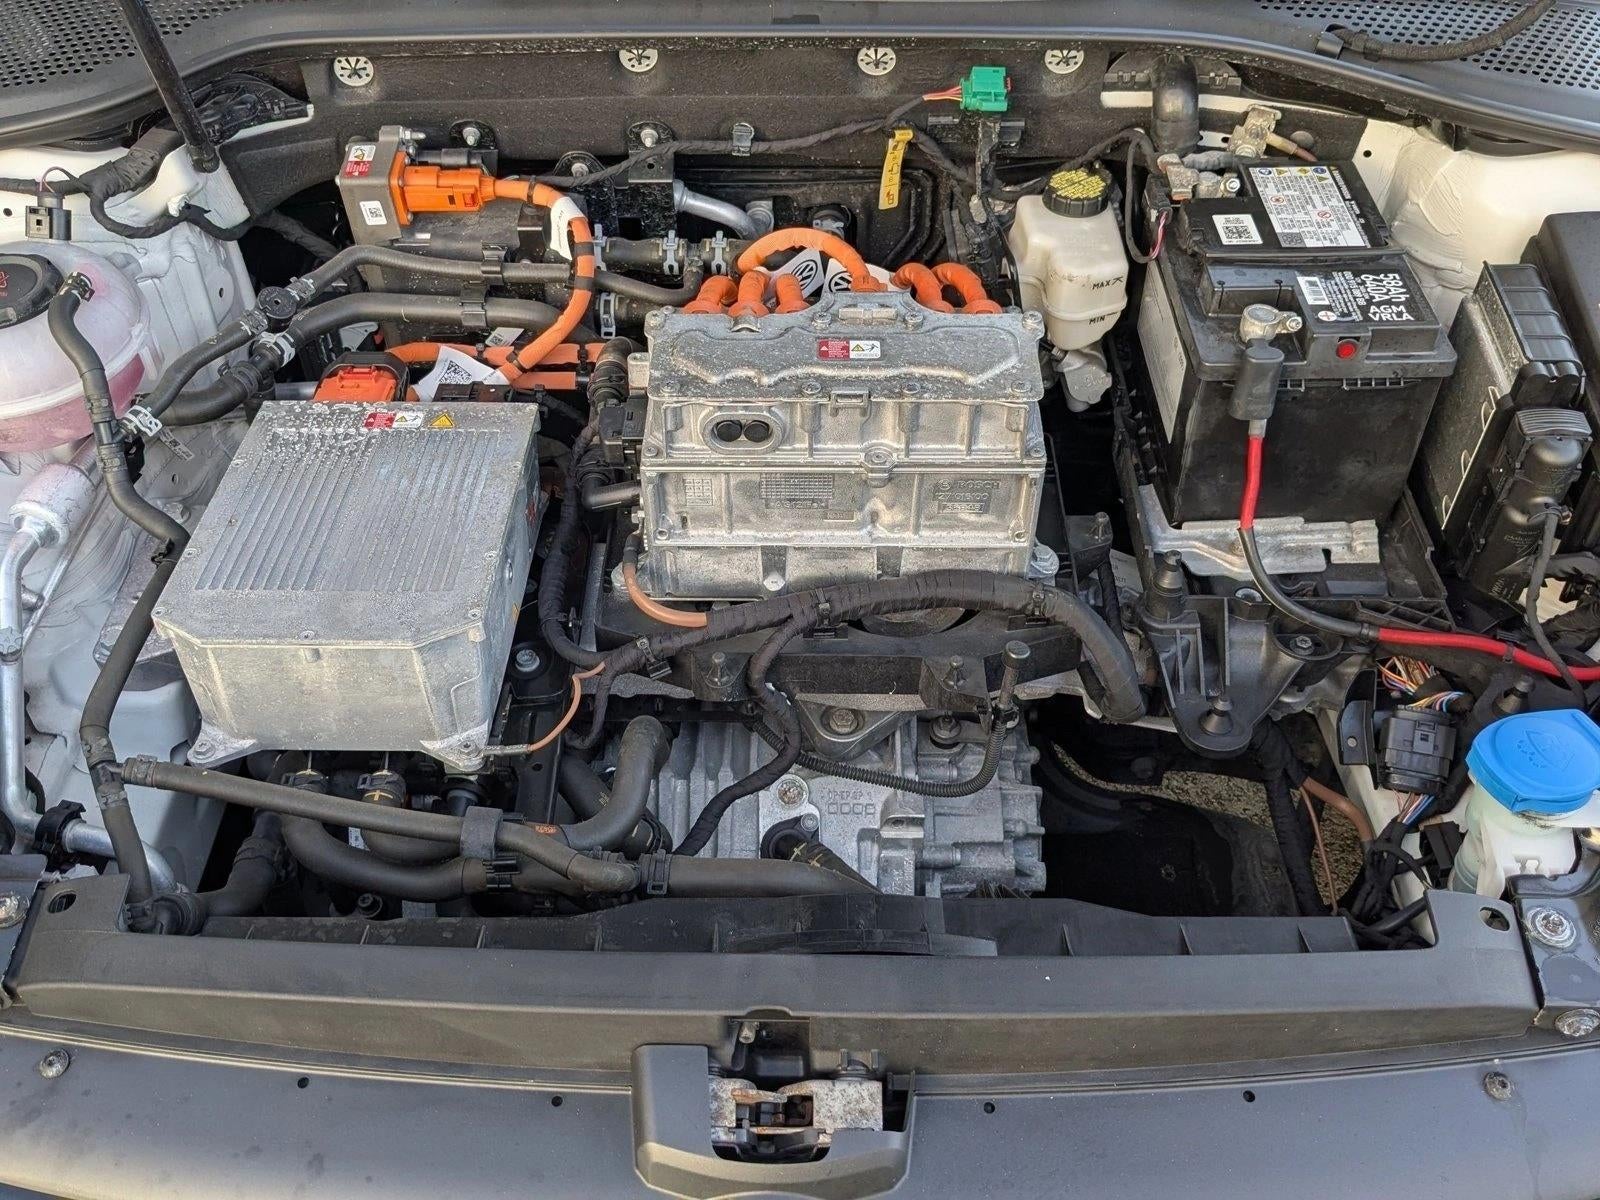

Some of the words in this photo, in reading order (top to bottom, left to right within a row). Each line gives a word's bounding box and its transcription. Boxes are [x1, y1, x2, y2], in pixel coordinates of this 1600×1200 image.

[1092, 280, 1111, 290] MAX
[1361, 273, 1391, 303] 640A
[1380, 273, 1410, 302] 58Ah
[1370, 305, 1407, 313] AGM
[1089, 315, 1106, 325] MIN
[1368, 313, 1415, 321] VRLA
